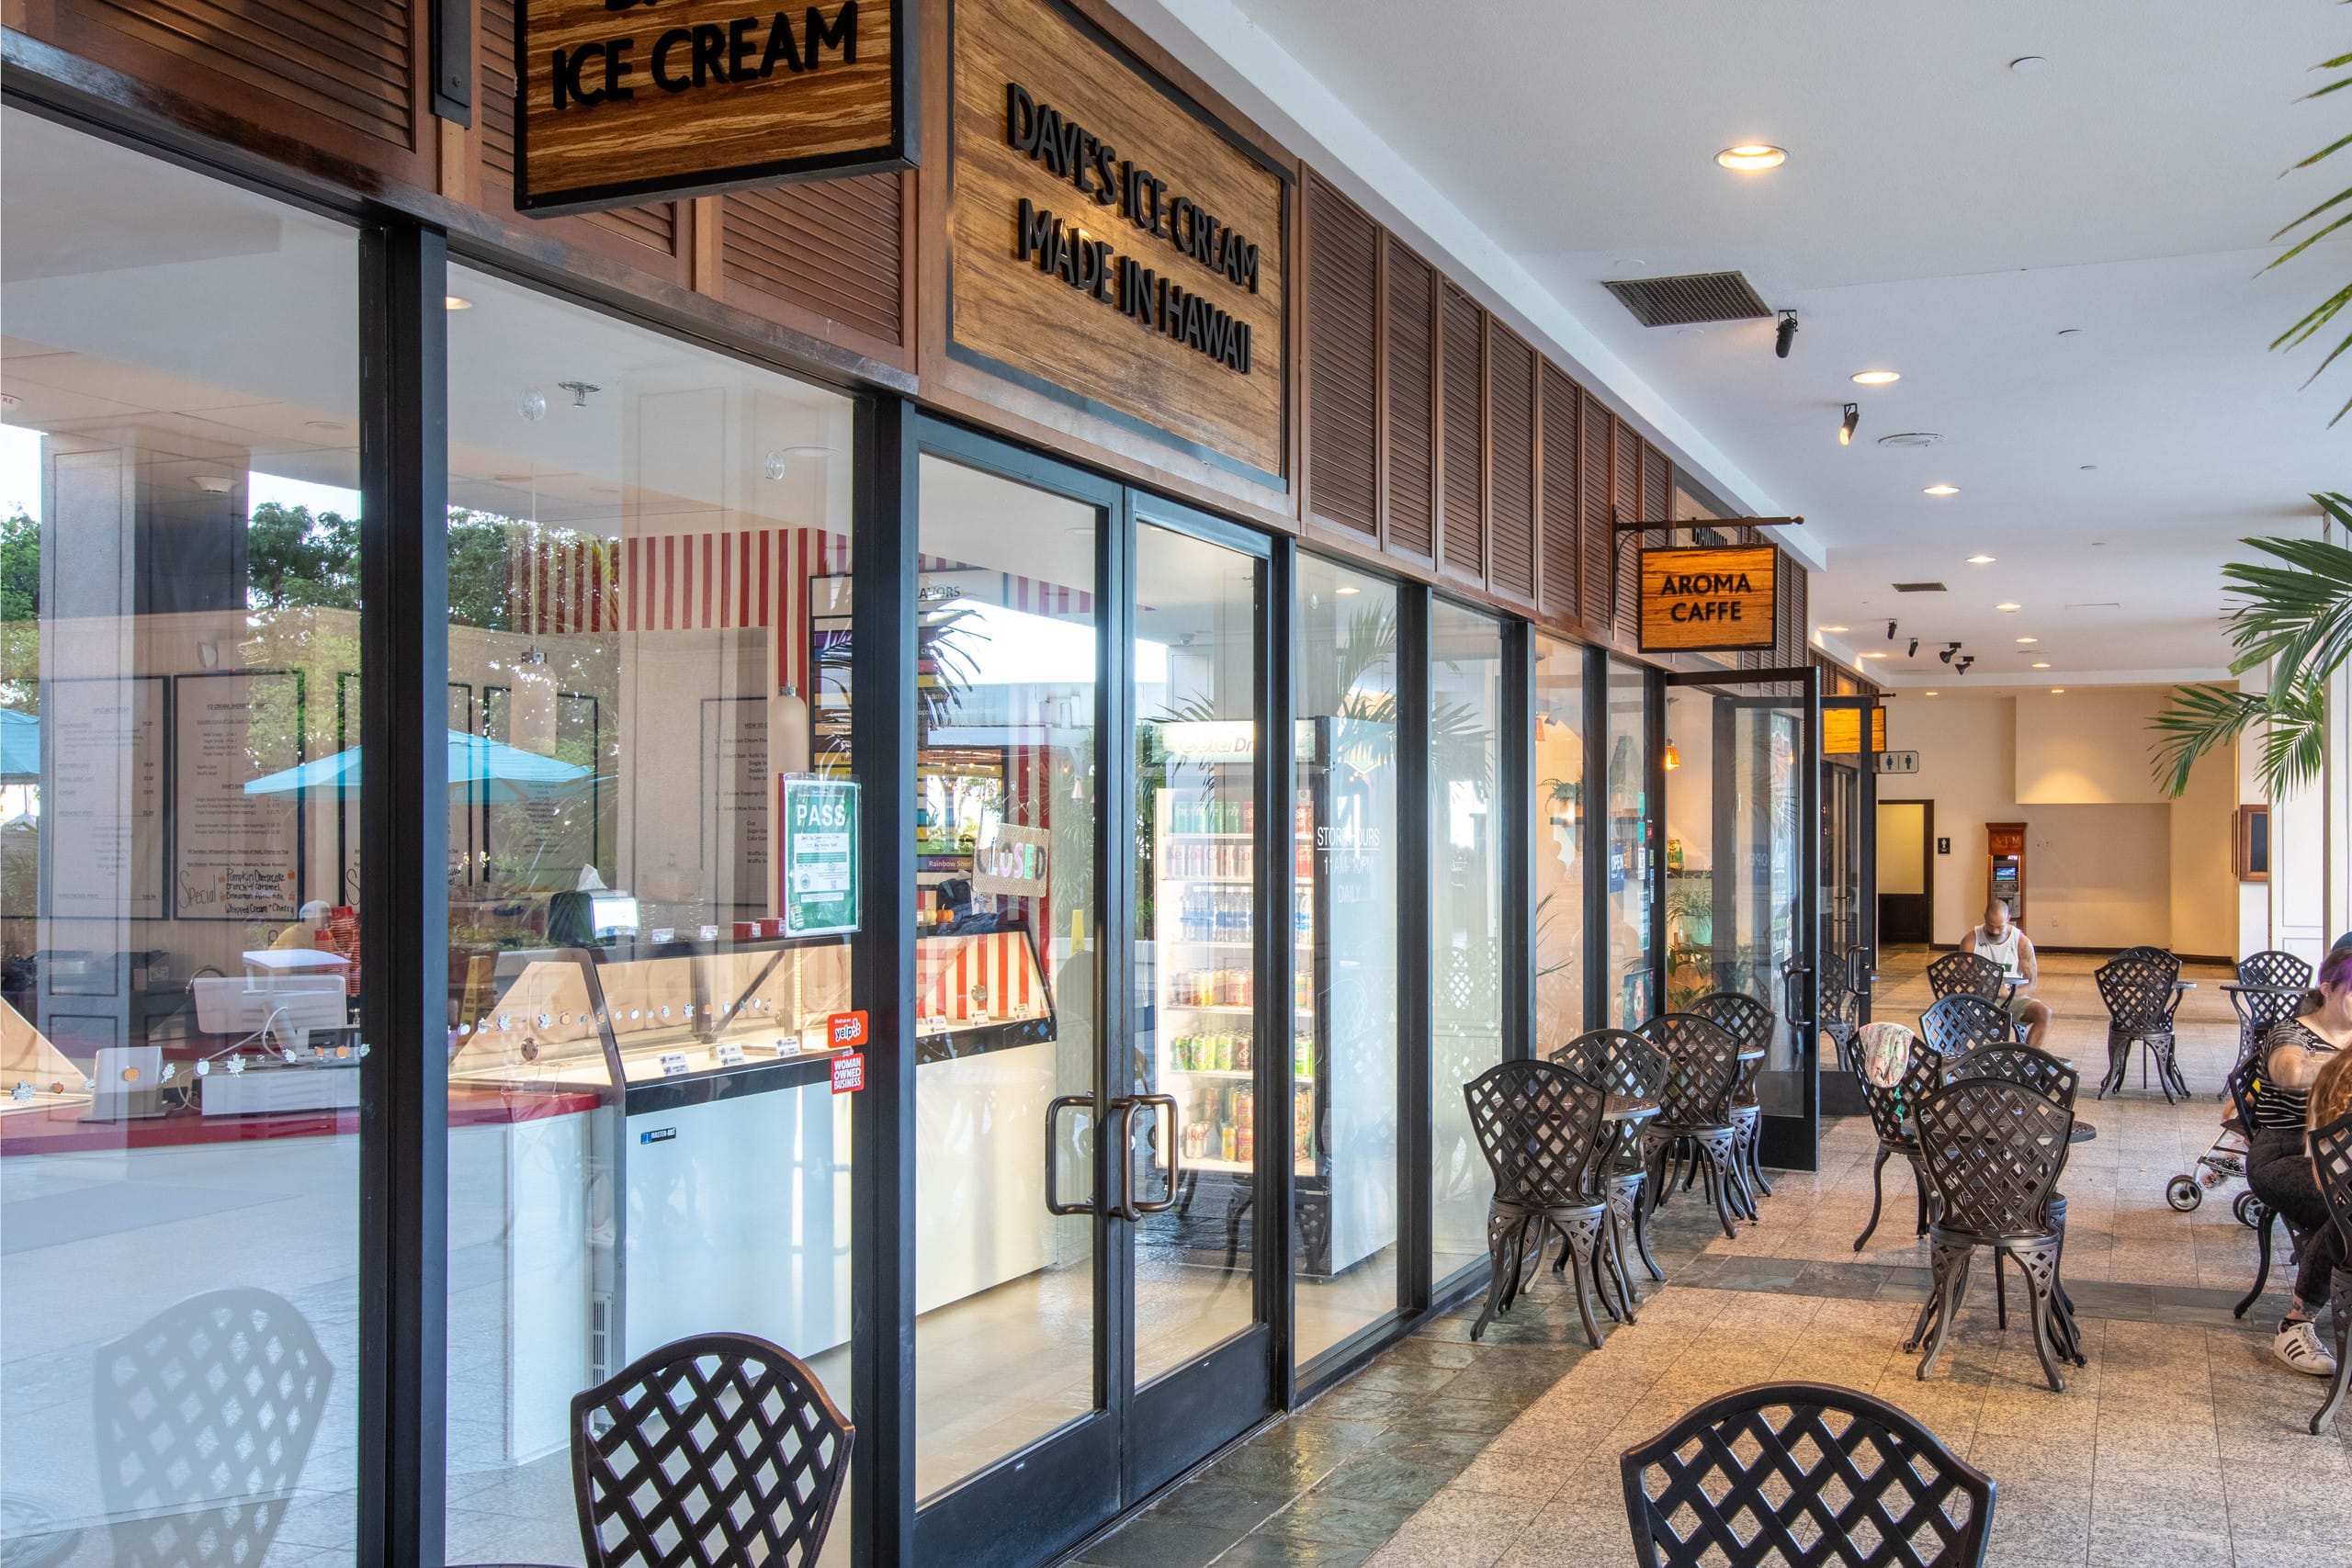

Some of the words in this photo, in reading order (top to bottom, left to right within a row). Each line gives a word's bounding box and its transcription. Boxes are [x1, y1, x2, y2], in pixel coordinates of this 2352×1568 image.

[551, 38, 635, 110] ICE
[650, 0, 859, 93] CREAM
[1006, 83, 1118, 205] DAVE'S
[1122, 160, 1169, 239] ICE
[1170, 196, 1259, 295] CREAM
[1018, 197, 1114, 304] MADE
[1119, 255, 1156, 325] IN
[1159, 277, 1251, 375] HAWAII
[919, 586, 961, 600] AVORS
[1660, 572, 1752, 596] AROMA
[1670, 600, 1742, 622] CAFFE
[797, 804, 846, 827] PASS
[1317, 826, 1348, 846] STORE
[1351, 827, 1380, 846] HOURS
[1611, 854, 1623, 872] OPEN
[226, 868, 254, 883] Pumpkin
[179, 869, 217, 910] Special
[1337, 883, 1362, 904] DAILY
[834, 1025, 853, 1041] yelp
[833, 1066, 862, 1081] OWNED
[834, 1056, 862, 1071] WOMAN
[833, 1077, 862, 1090] BUSINESS
